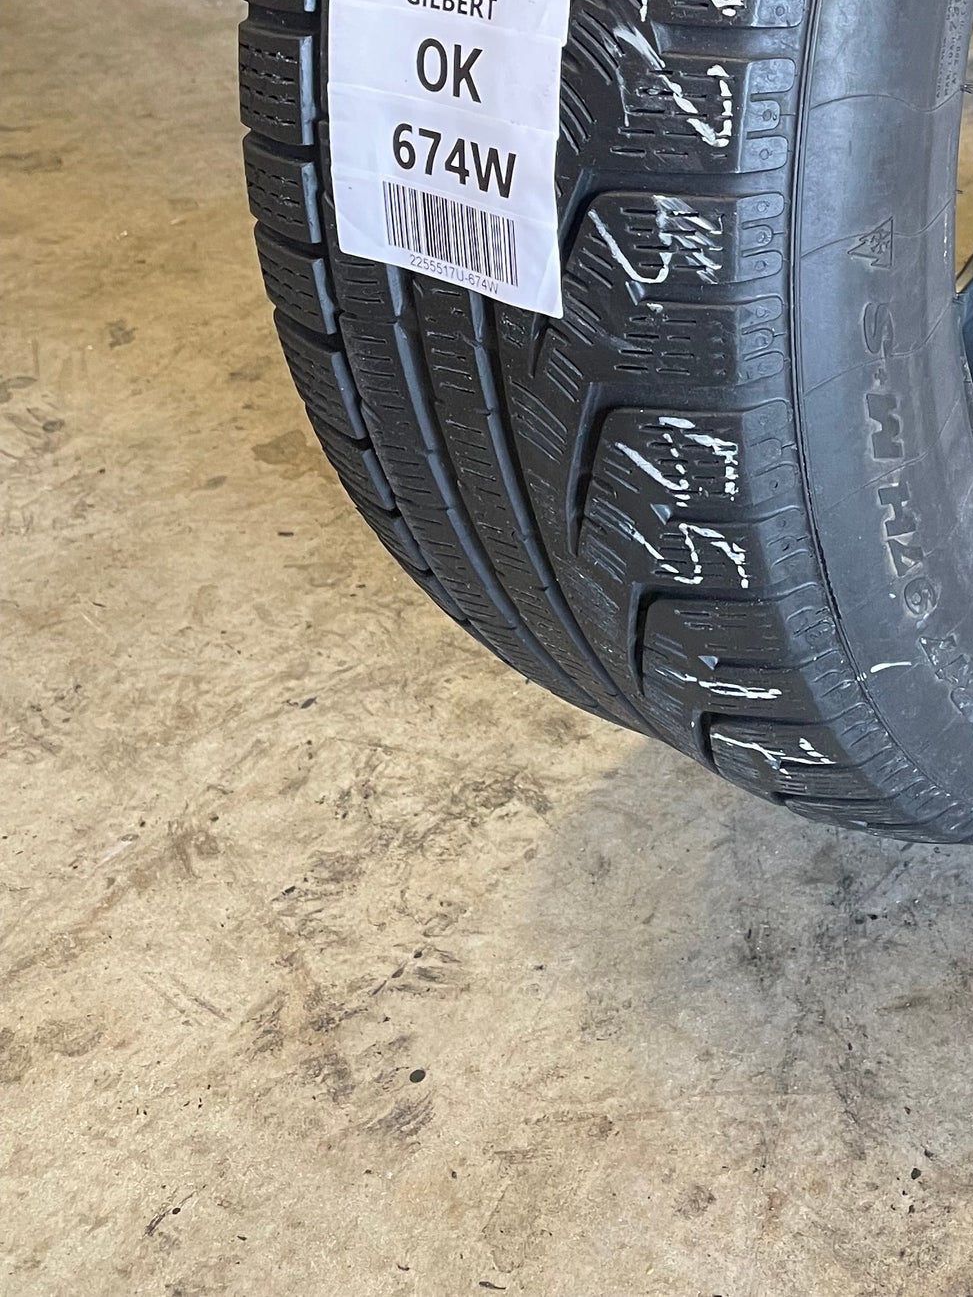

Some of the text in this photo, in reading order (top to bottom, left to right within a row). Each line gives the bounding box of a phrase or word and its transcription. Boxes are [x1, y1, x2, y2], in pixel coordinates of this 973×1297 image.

[415, 38, 484, 104] OK
[392, 123, 517, 199] 674W
[408, 253, 500, 296] 2255517U-674W
